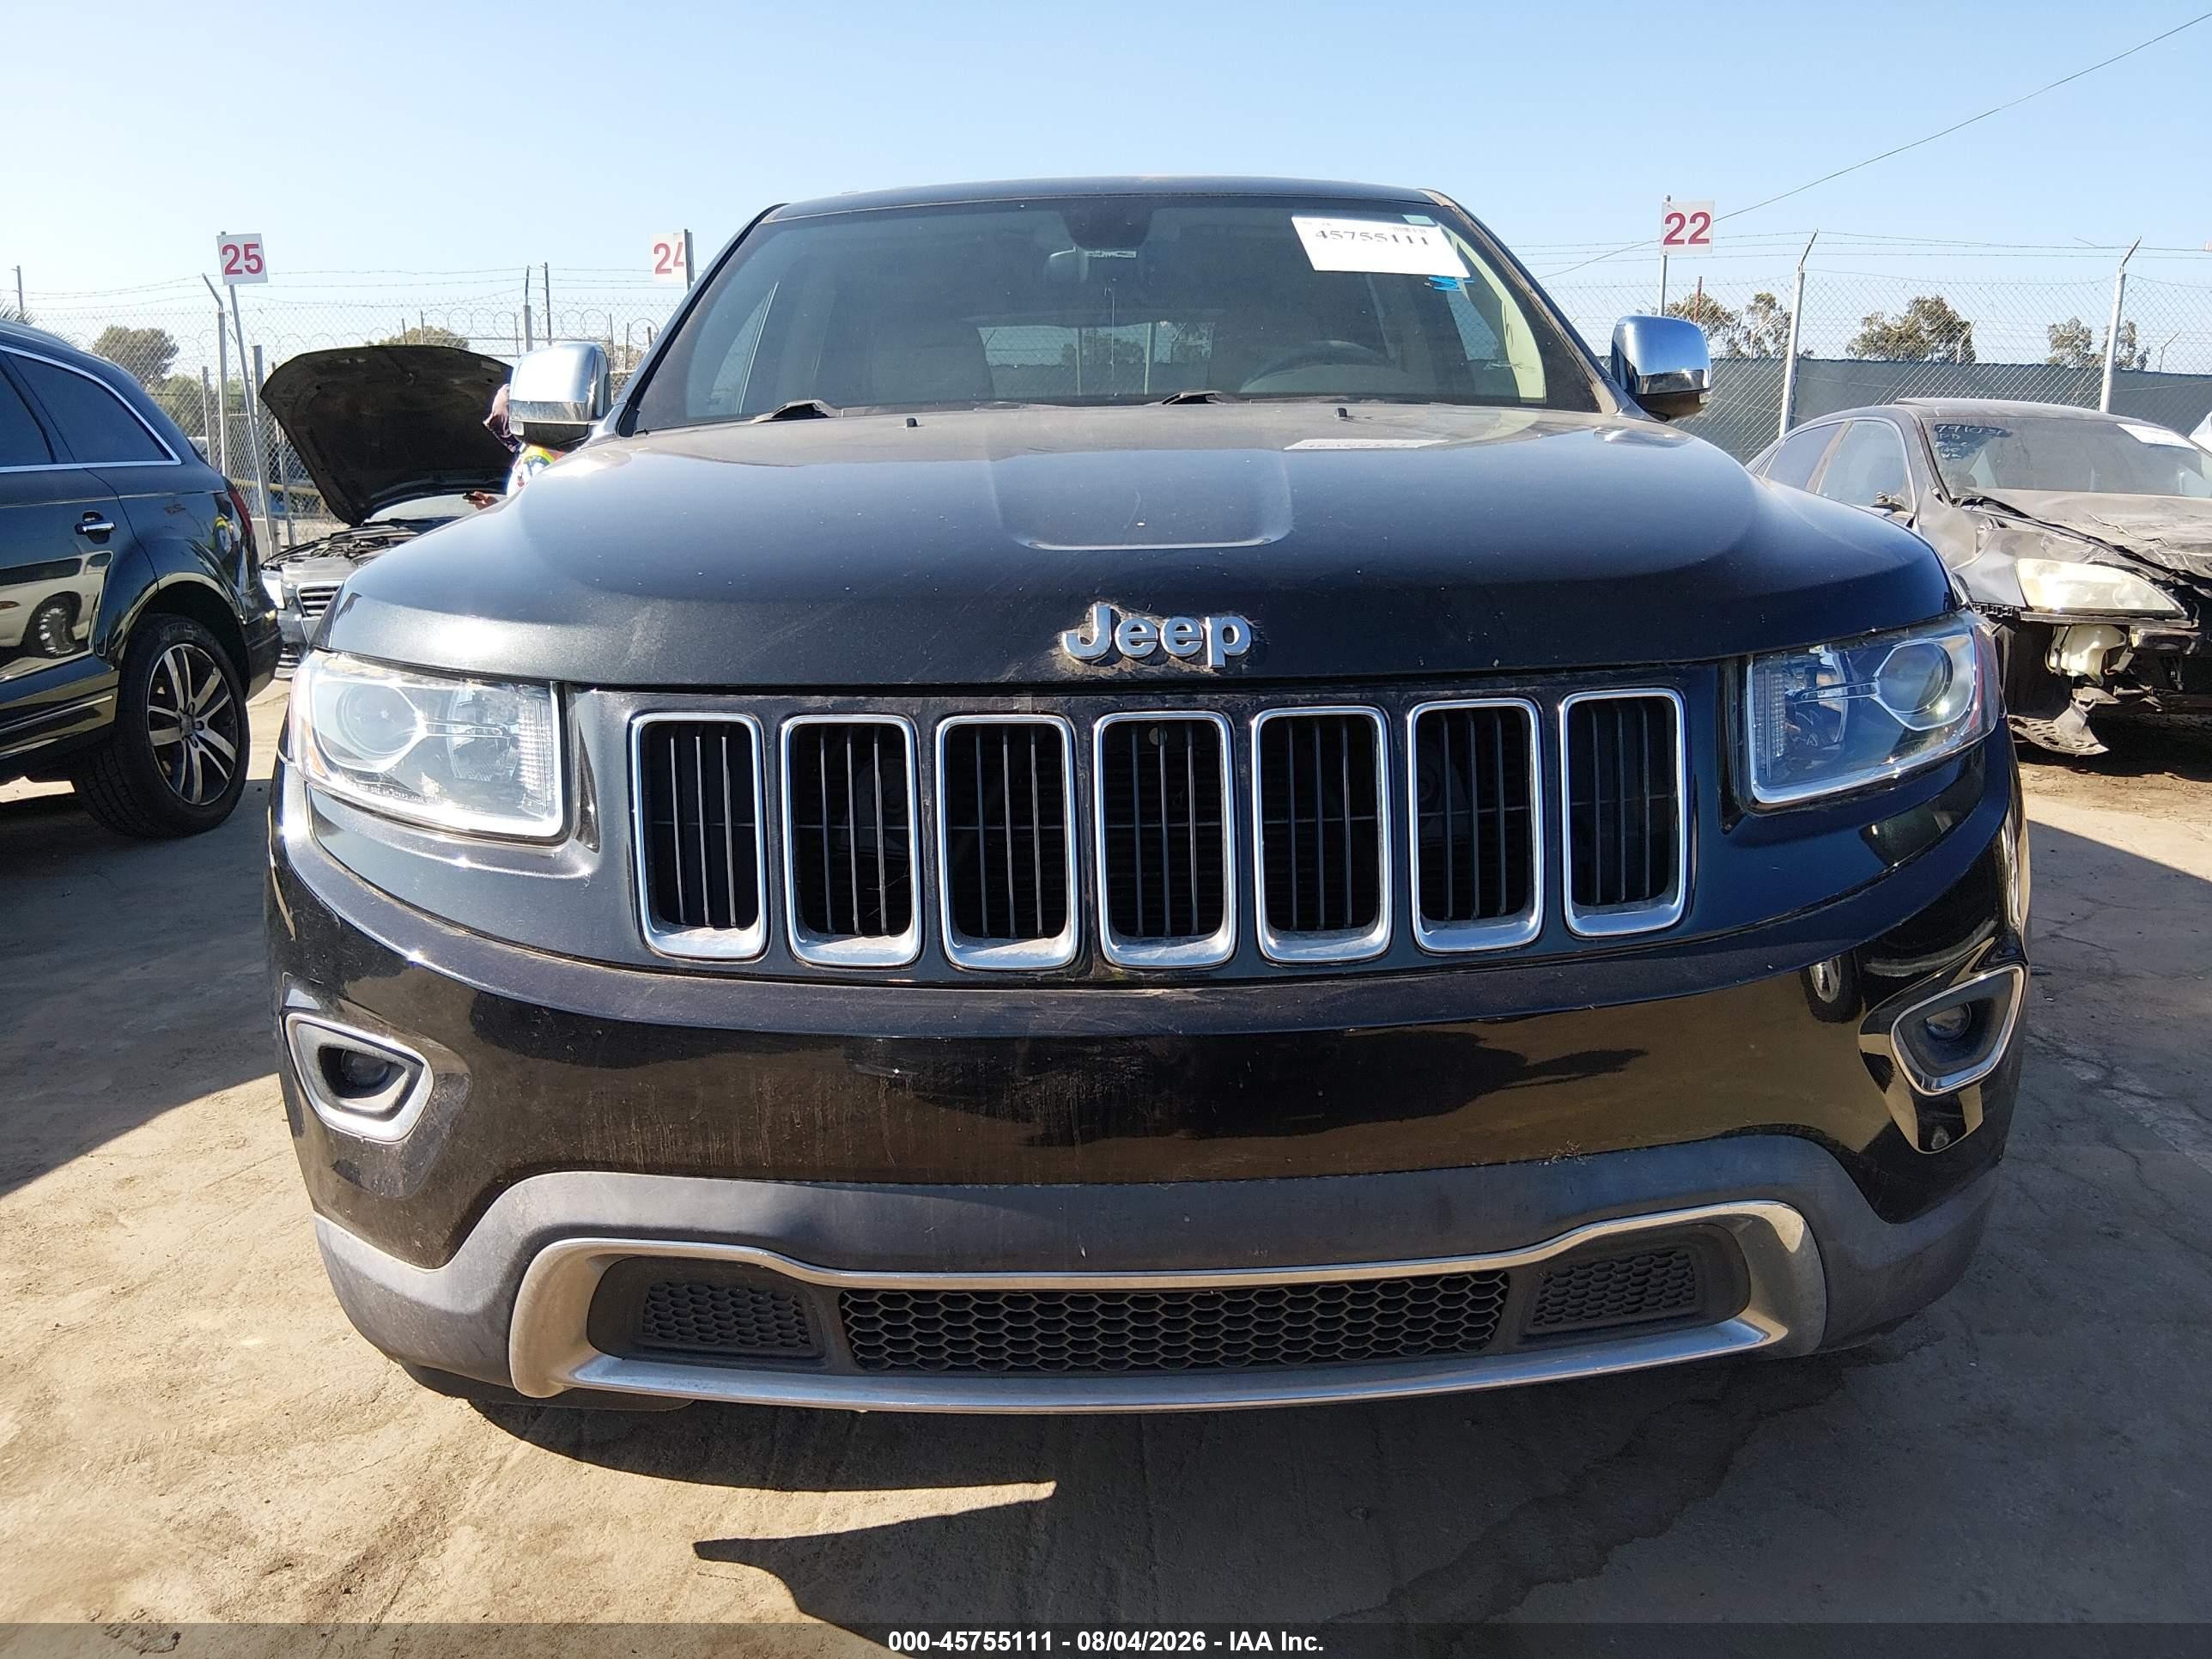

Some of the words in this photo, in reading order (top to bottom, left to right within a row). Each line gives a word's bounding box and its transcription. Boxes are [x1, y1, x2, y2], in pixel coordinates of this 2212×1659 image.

[1315, 229, 1430, 246] 45755111
[1663, 211, 1711, 246] 22
[222, 243, 263, 275] 25
[1061, 604, 1252, 669] Jeep
